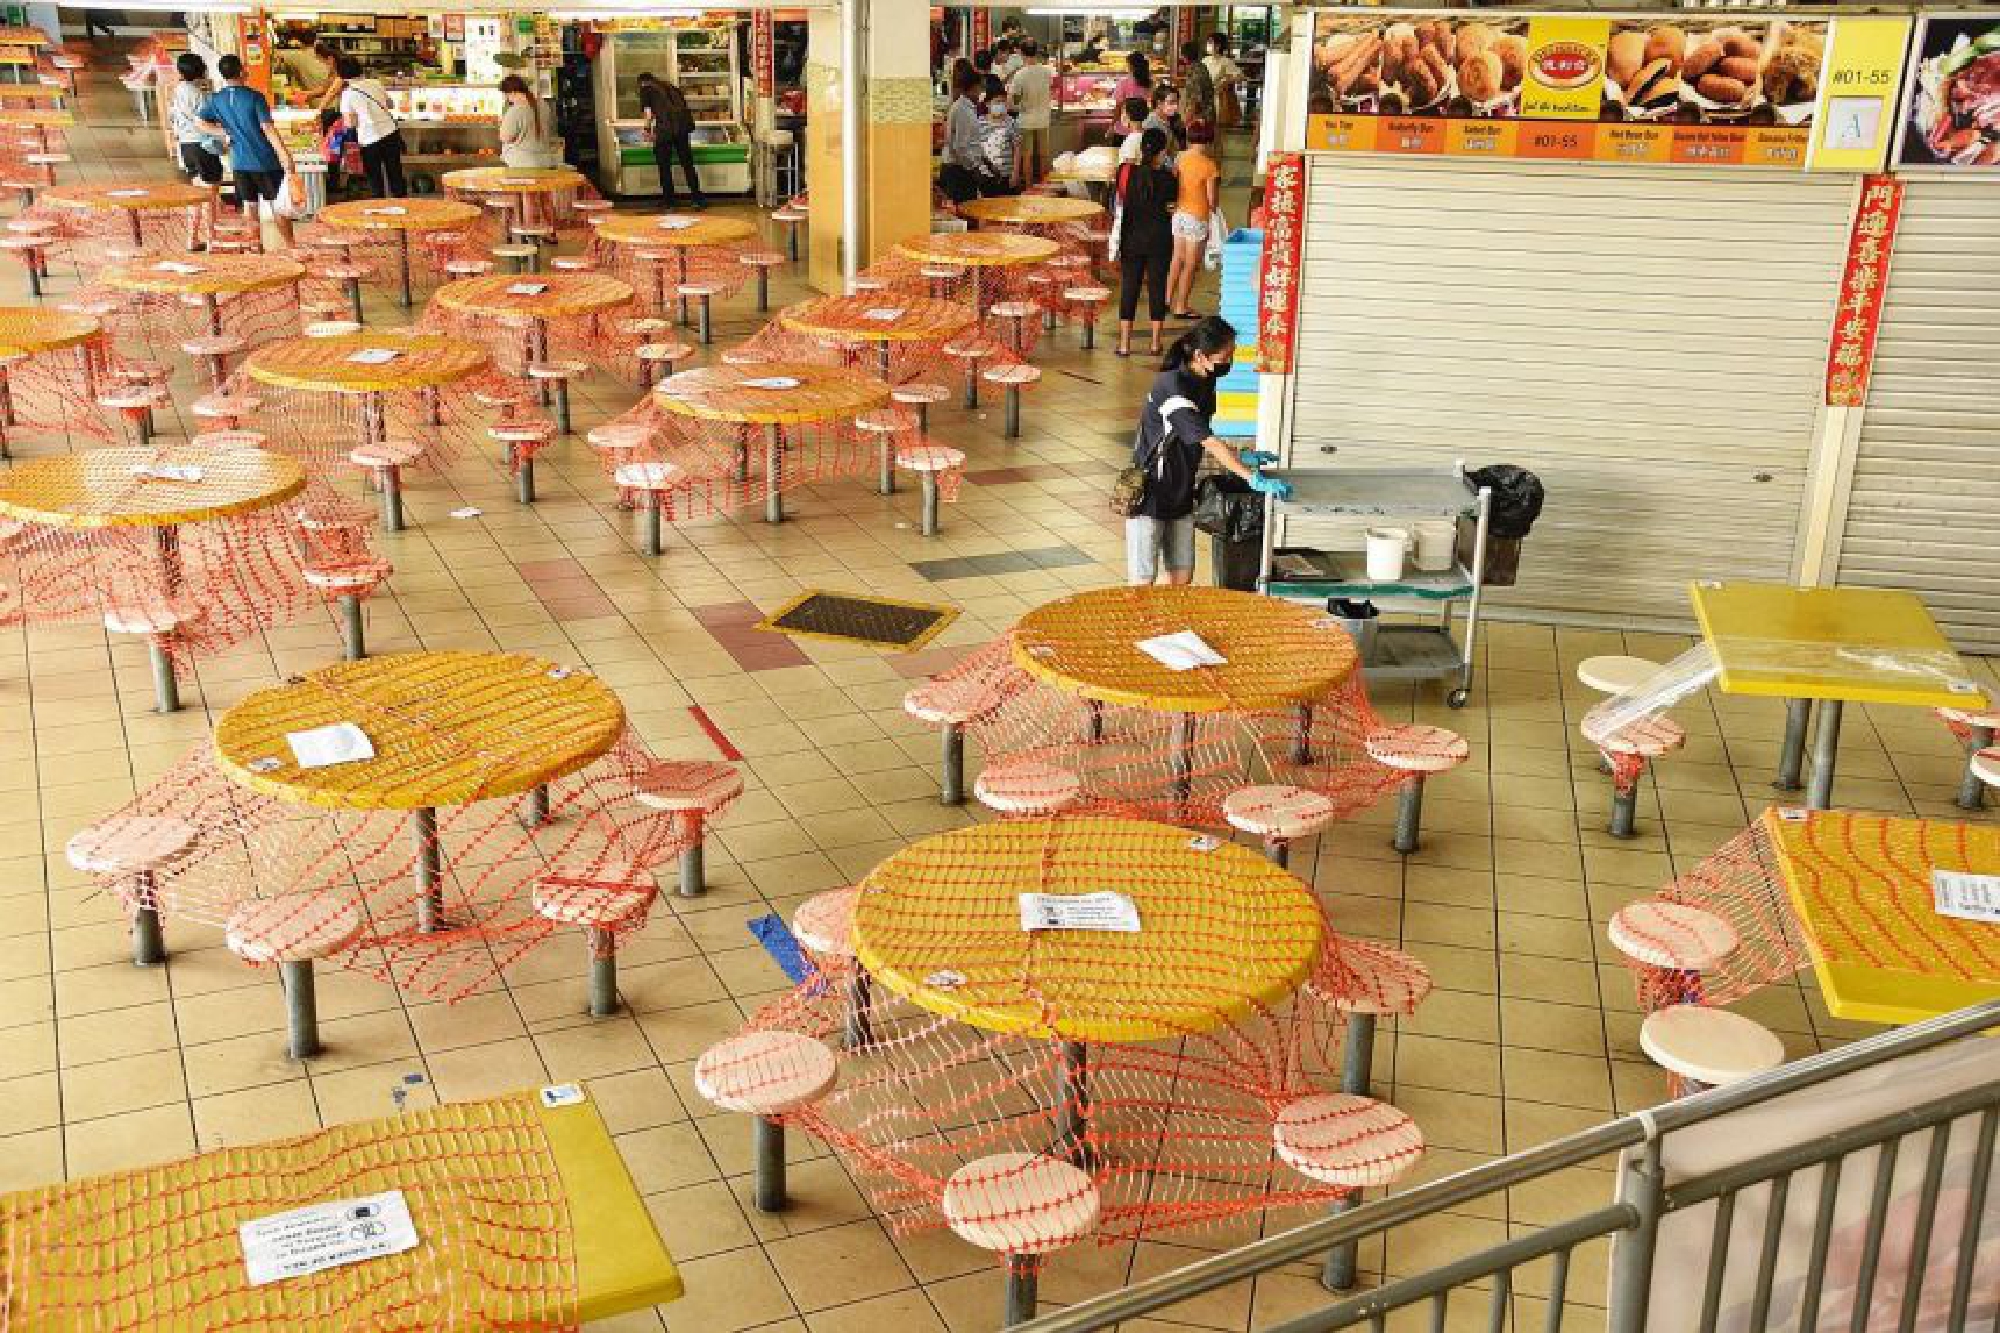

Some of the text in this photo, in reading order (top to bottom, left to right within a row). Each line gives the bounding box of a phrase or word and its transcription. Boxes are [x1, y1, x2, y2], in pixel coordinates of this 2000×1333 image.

[1832, 69, 1891, 84] #01-55
[1842, 113, 1860, 138] A
[1534, 134, 1578, 148] #01-55
